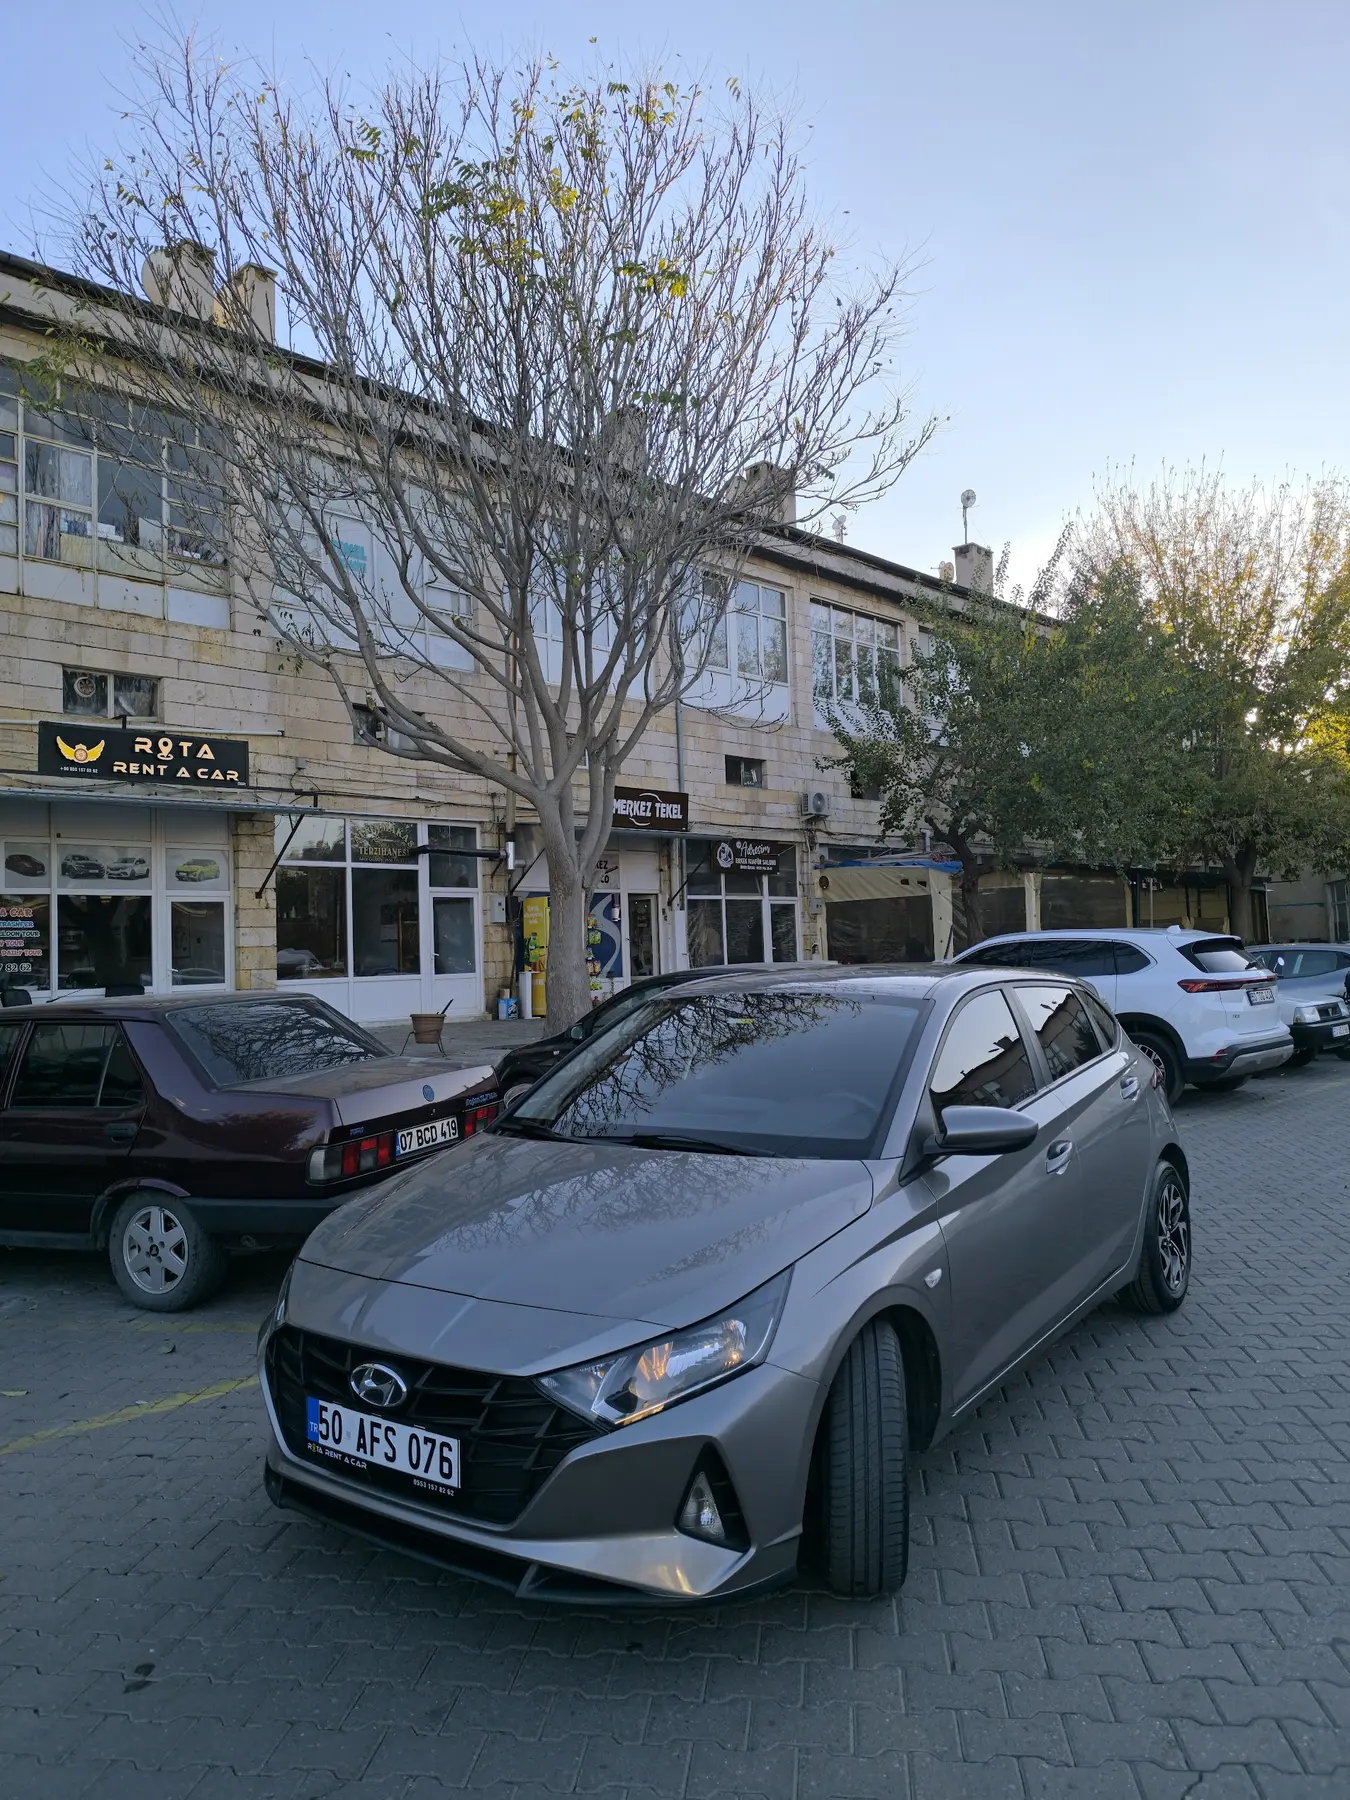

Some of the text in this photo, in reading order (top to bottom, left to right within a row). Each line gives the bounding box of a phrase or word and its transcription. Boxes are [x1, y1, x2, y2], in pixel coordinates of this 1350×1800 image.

[113, 761, 239, 782] RENT A CAR
[613, 799, 682, 819] MERKEZ TEKEL
[9, 908, 33, 917] CAR
[5, 963, 18, 972] 82
[20, 963, 31, 972] 62
[400, 1119, 457, 1151] 07 BCD 419
[309, 1421, 318, 1433] TR
[319, 1405, 453, 1480] 50 AFS 076
[325, 1449, 342, 1461] RENT
[344, 1456, 350, 1464] A
[350, 1459, 367, 1470] CAR
